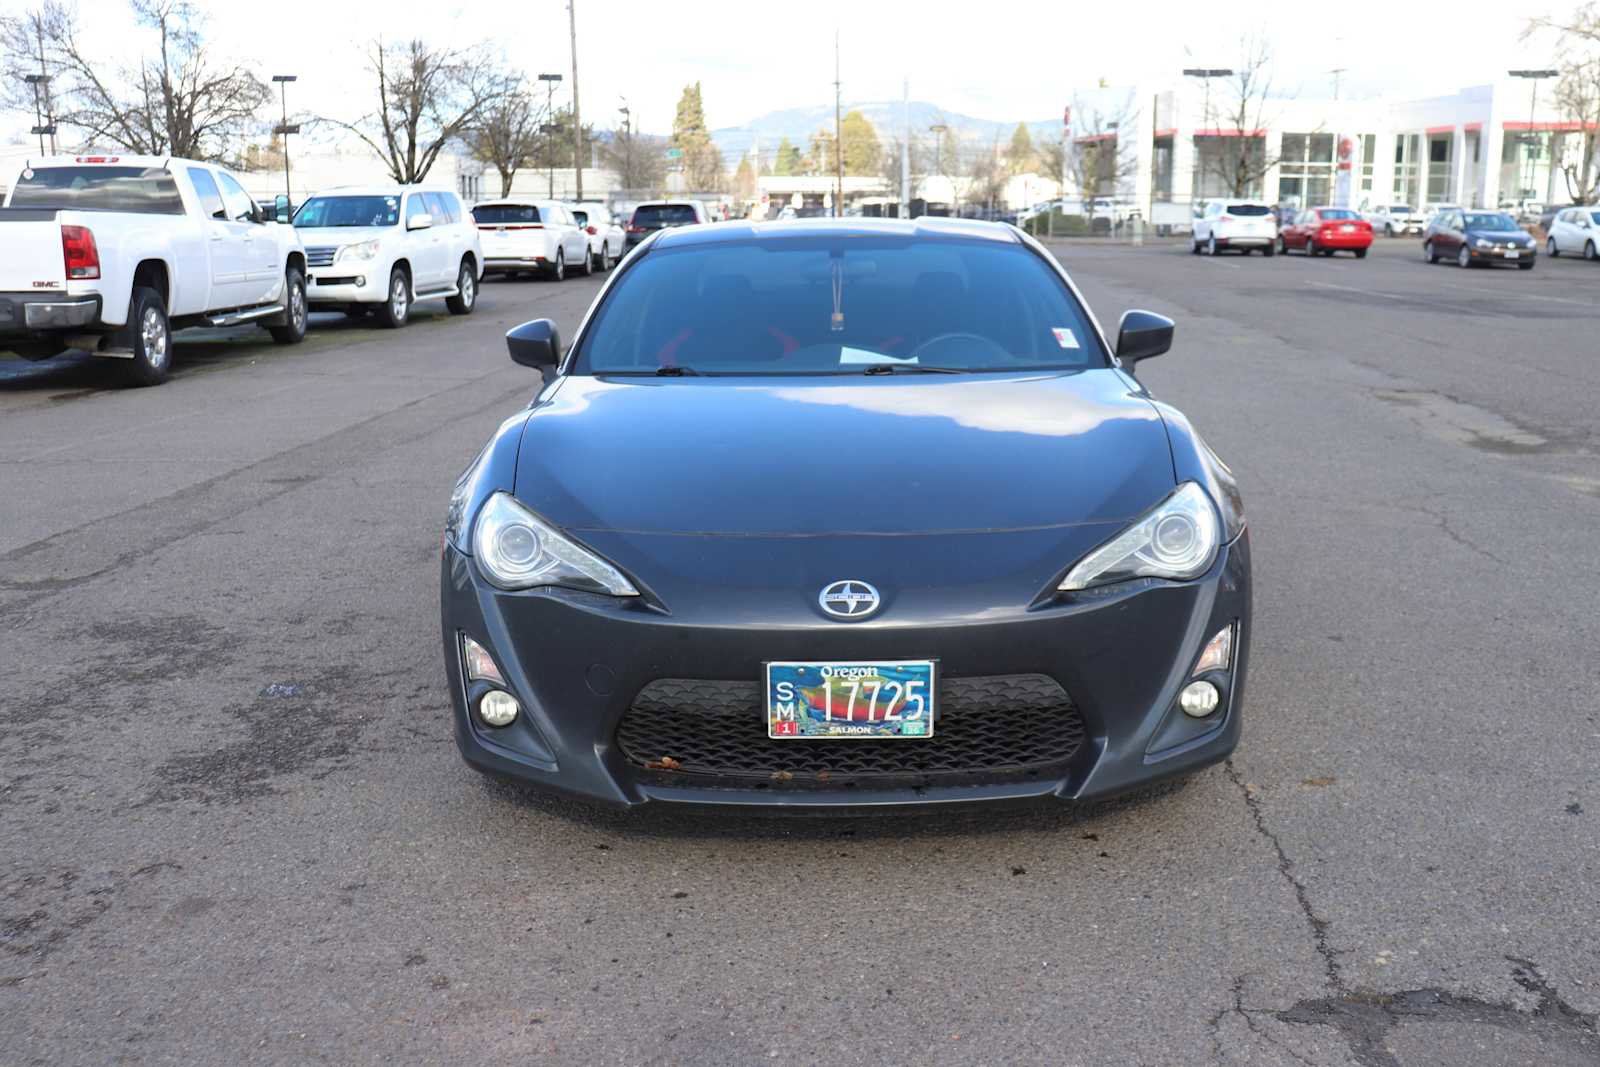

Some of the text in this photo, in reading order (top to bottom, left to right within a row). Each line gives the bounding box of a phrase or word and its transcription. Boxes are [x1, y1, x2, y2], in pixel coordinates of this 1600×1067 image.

[820, 666, 878, 681] Oregon
[822, 681, 924, 721] 17725
[782, 722, 791, 733] 1
[828, 726, 872, 734] SALMON
